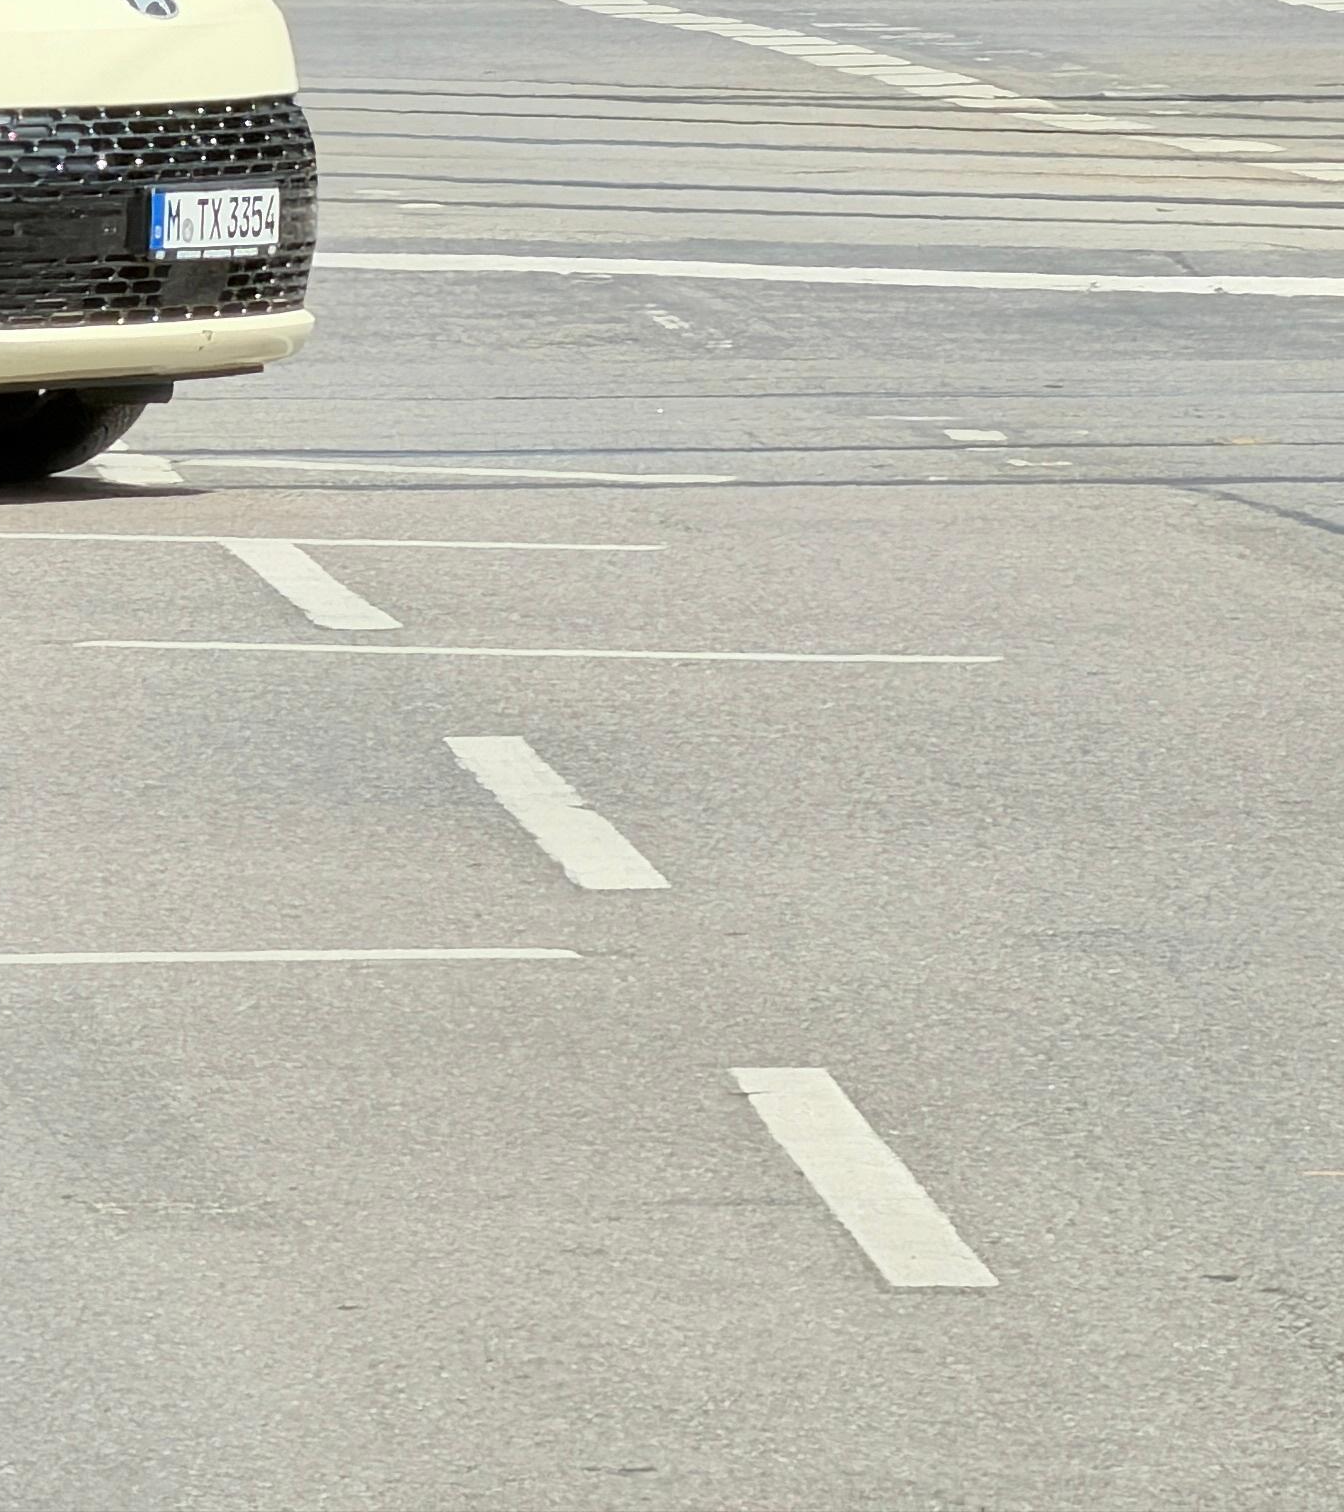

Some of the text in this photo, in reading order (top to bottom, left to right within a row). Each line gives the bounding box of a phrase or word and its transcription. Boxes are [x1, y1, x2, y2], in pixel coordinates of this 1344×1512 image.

[166, 194, 276, 241] M TX 3354
